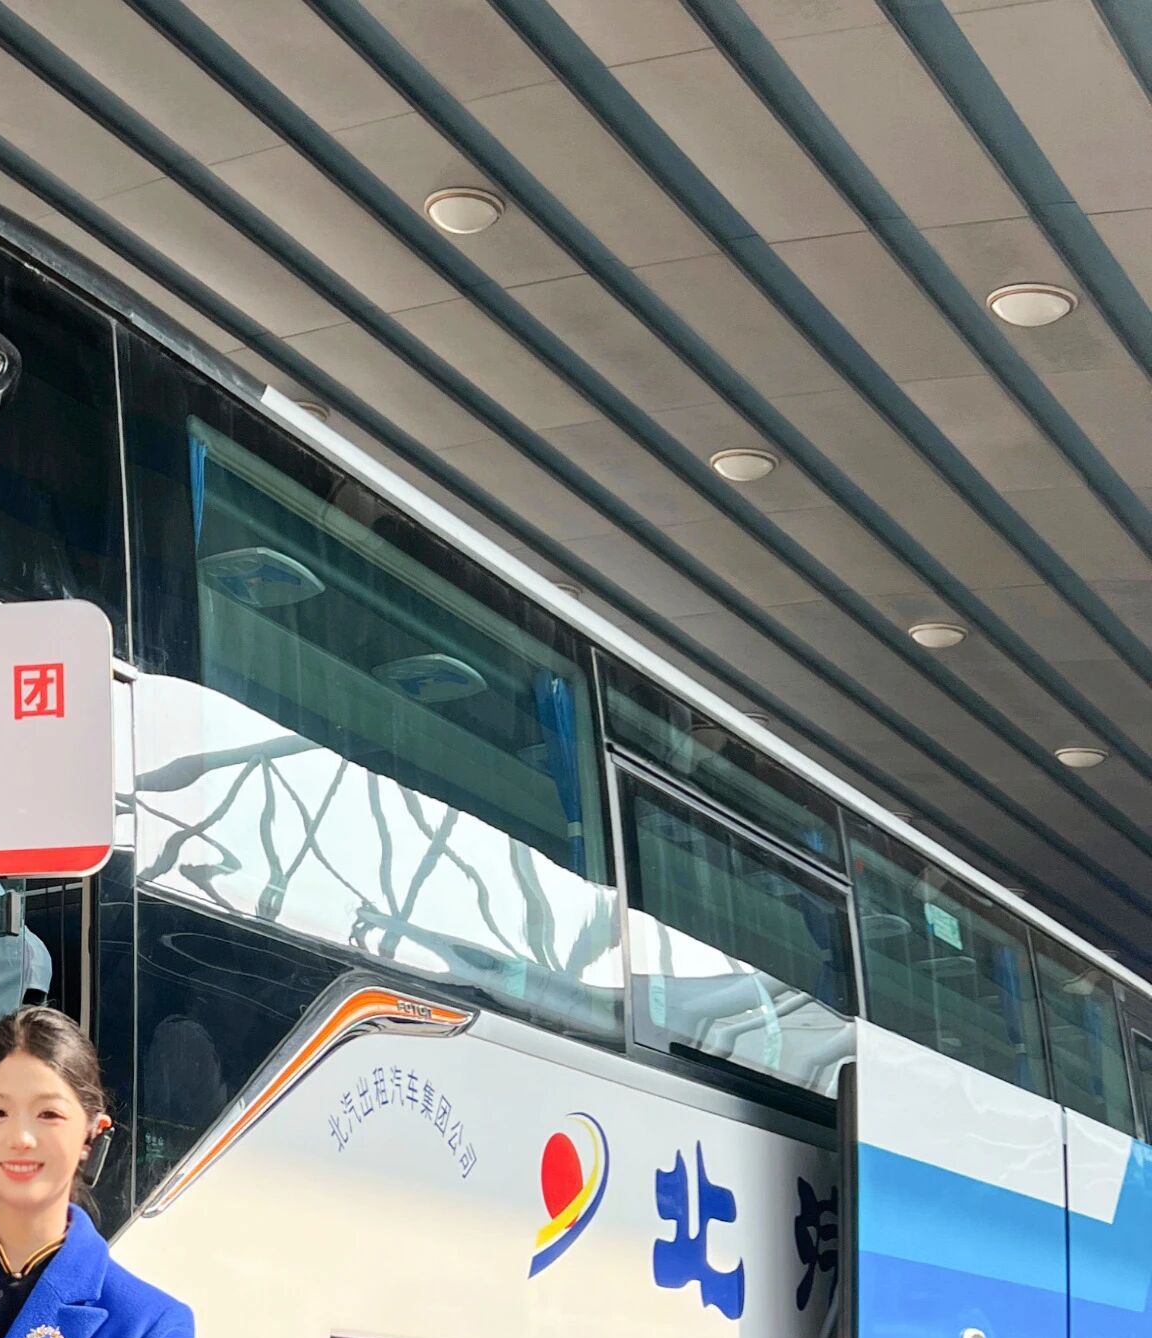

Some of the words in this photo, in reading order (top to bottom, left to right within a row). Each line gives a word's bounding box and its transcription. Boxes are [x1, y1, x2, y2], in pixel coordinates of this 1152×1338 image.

[328, 1064, 478, 1179] 北汽出租汽车集团公司
